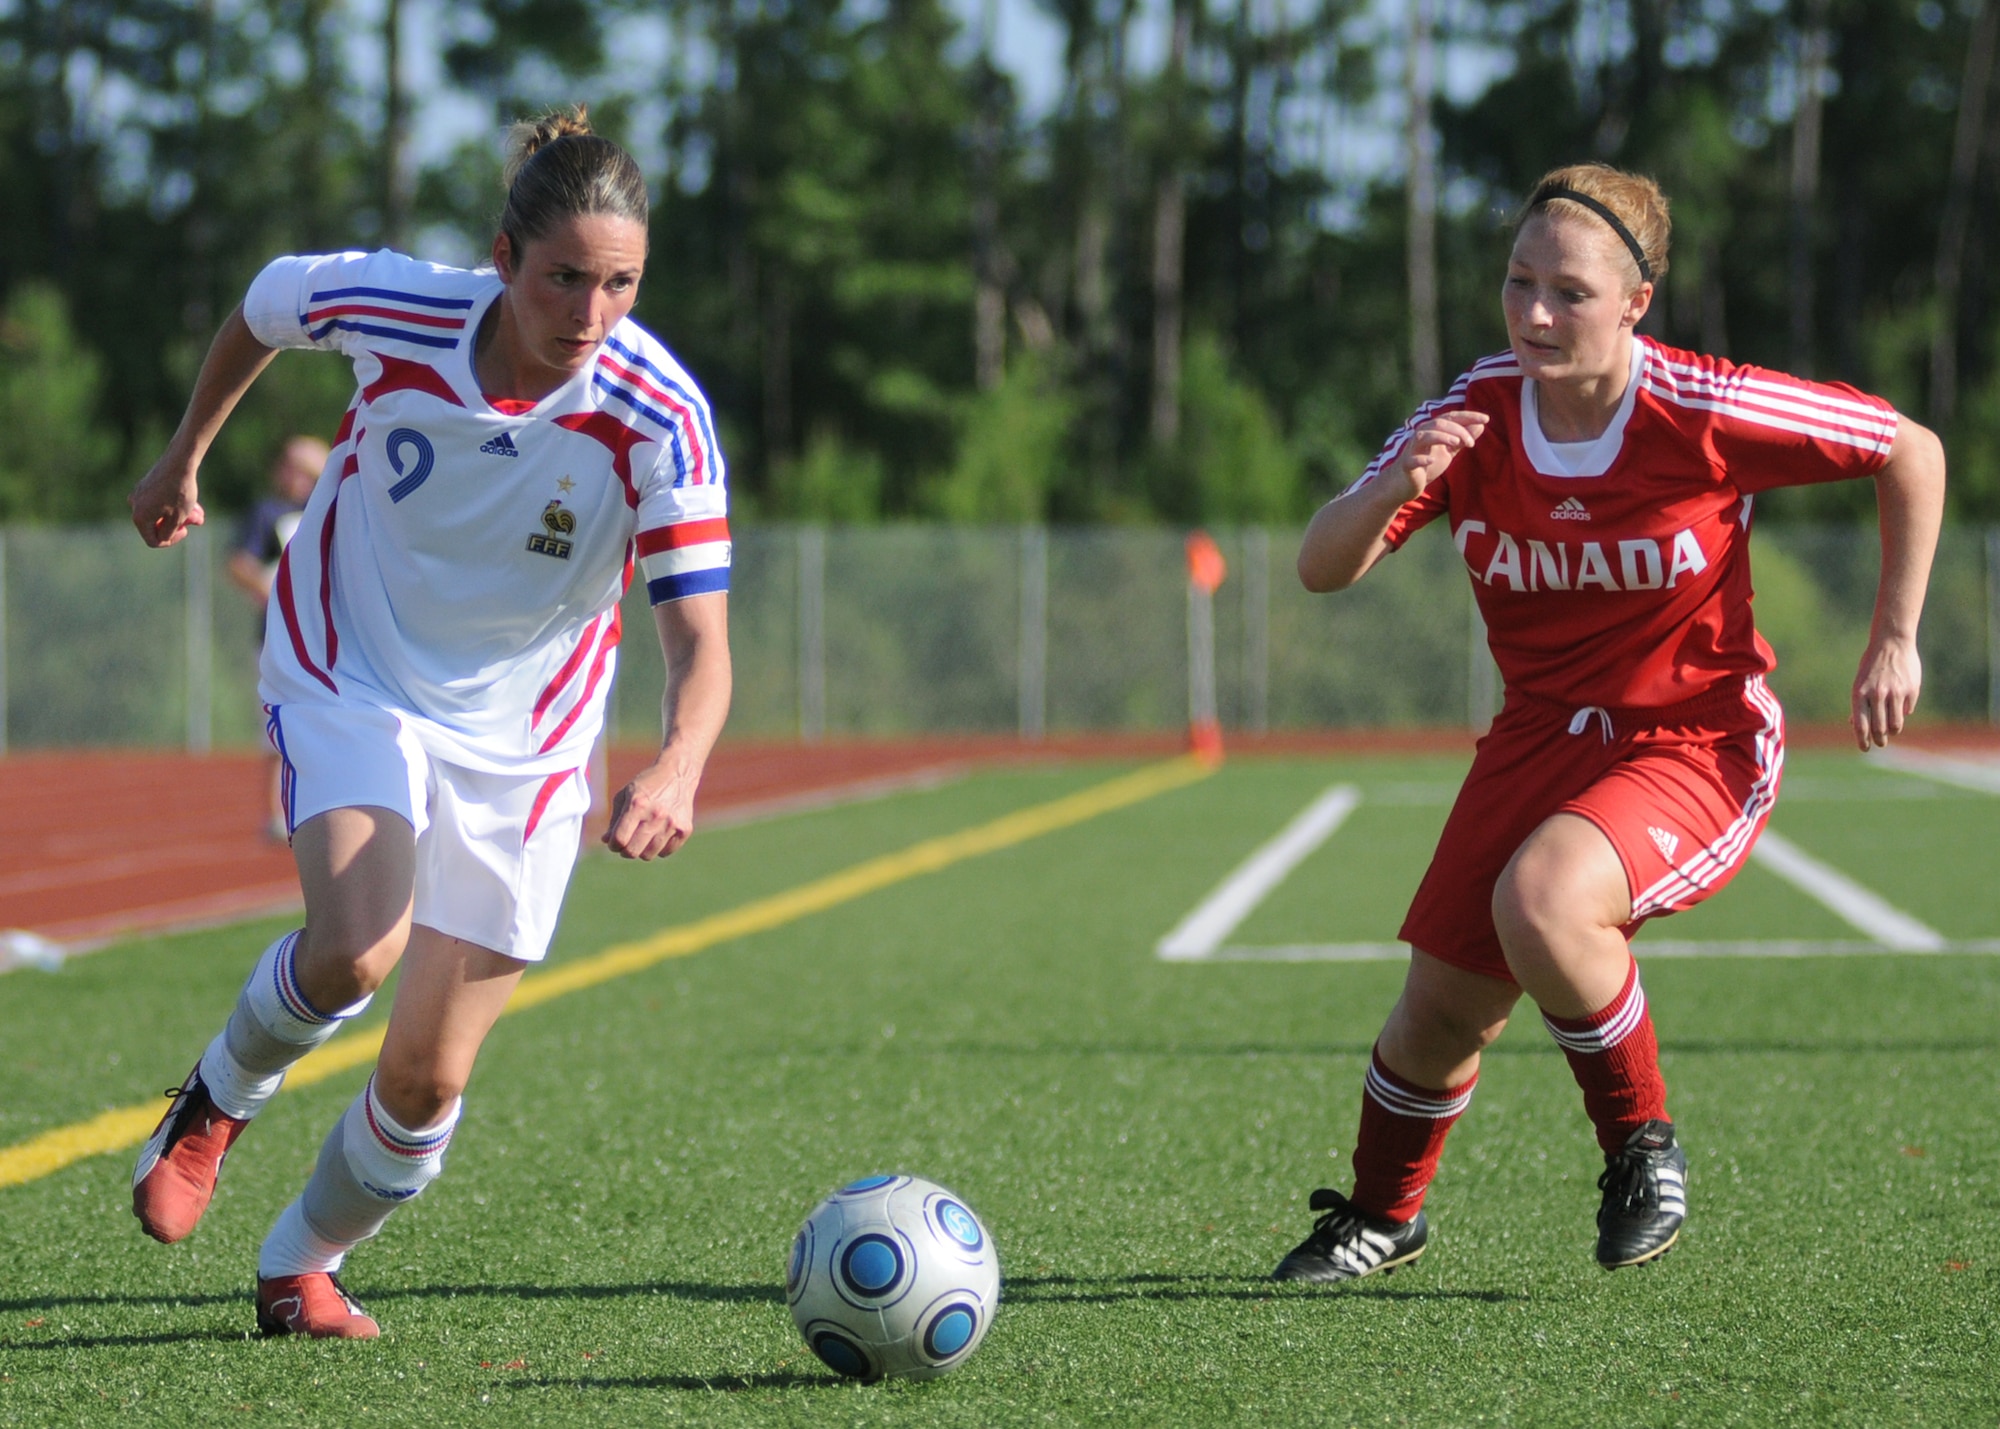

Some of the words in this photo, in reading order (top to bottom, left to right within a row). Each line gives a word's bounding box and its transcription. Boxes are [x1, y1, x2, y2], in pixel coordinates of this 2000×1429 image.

[386, 427, 435, 504] 9
[479, 444, 519, 458] adidas
[1550, 510, 1591, 521] adidas
[1454, 519, 1708, 592] CANADA
